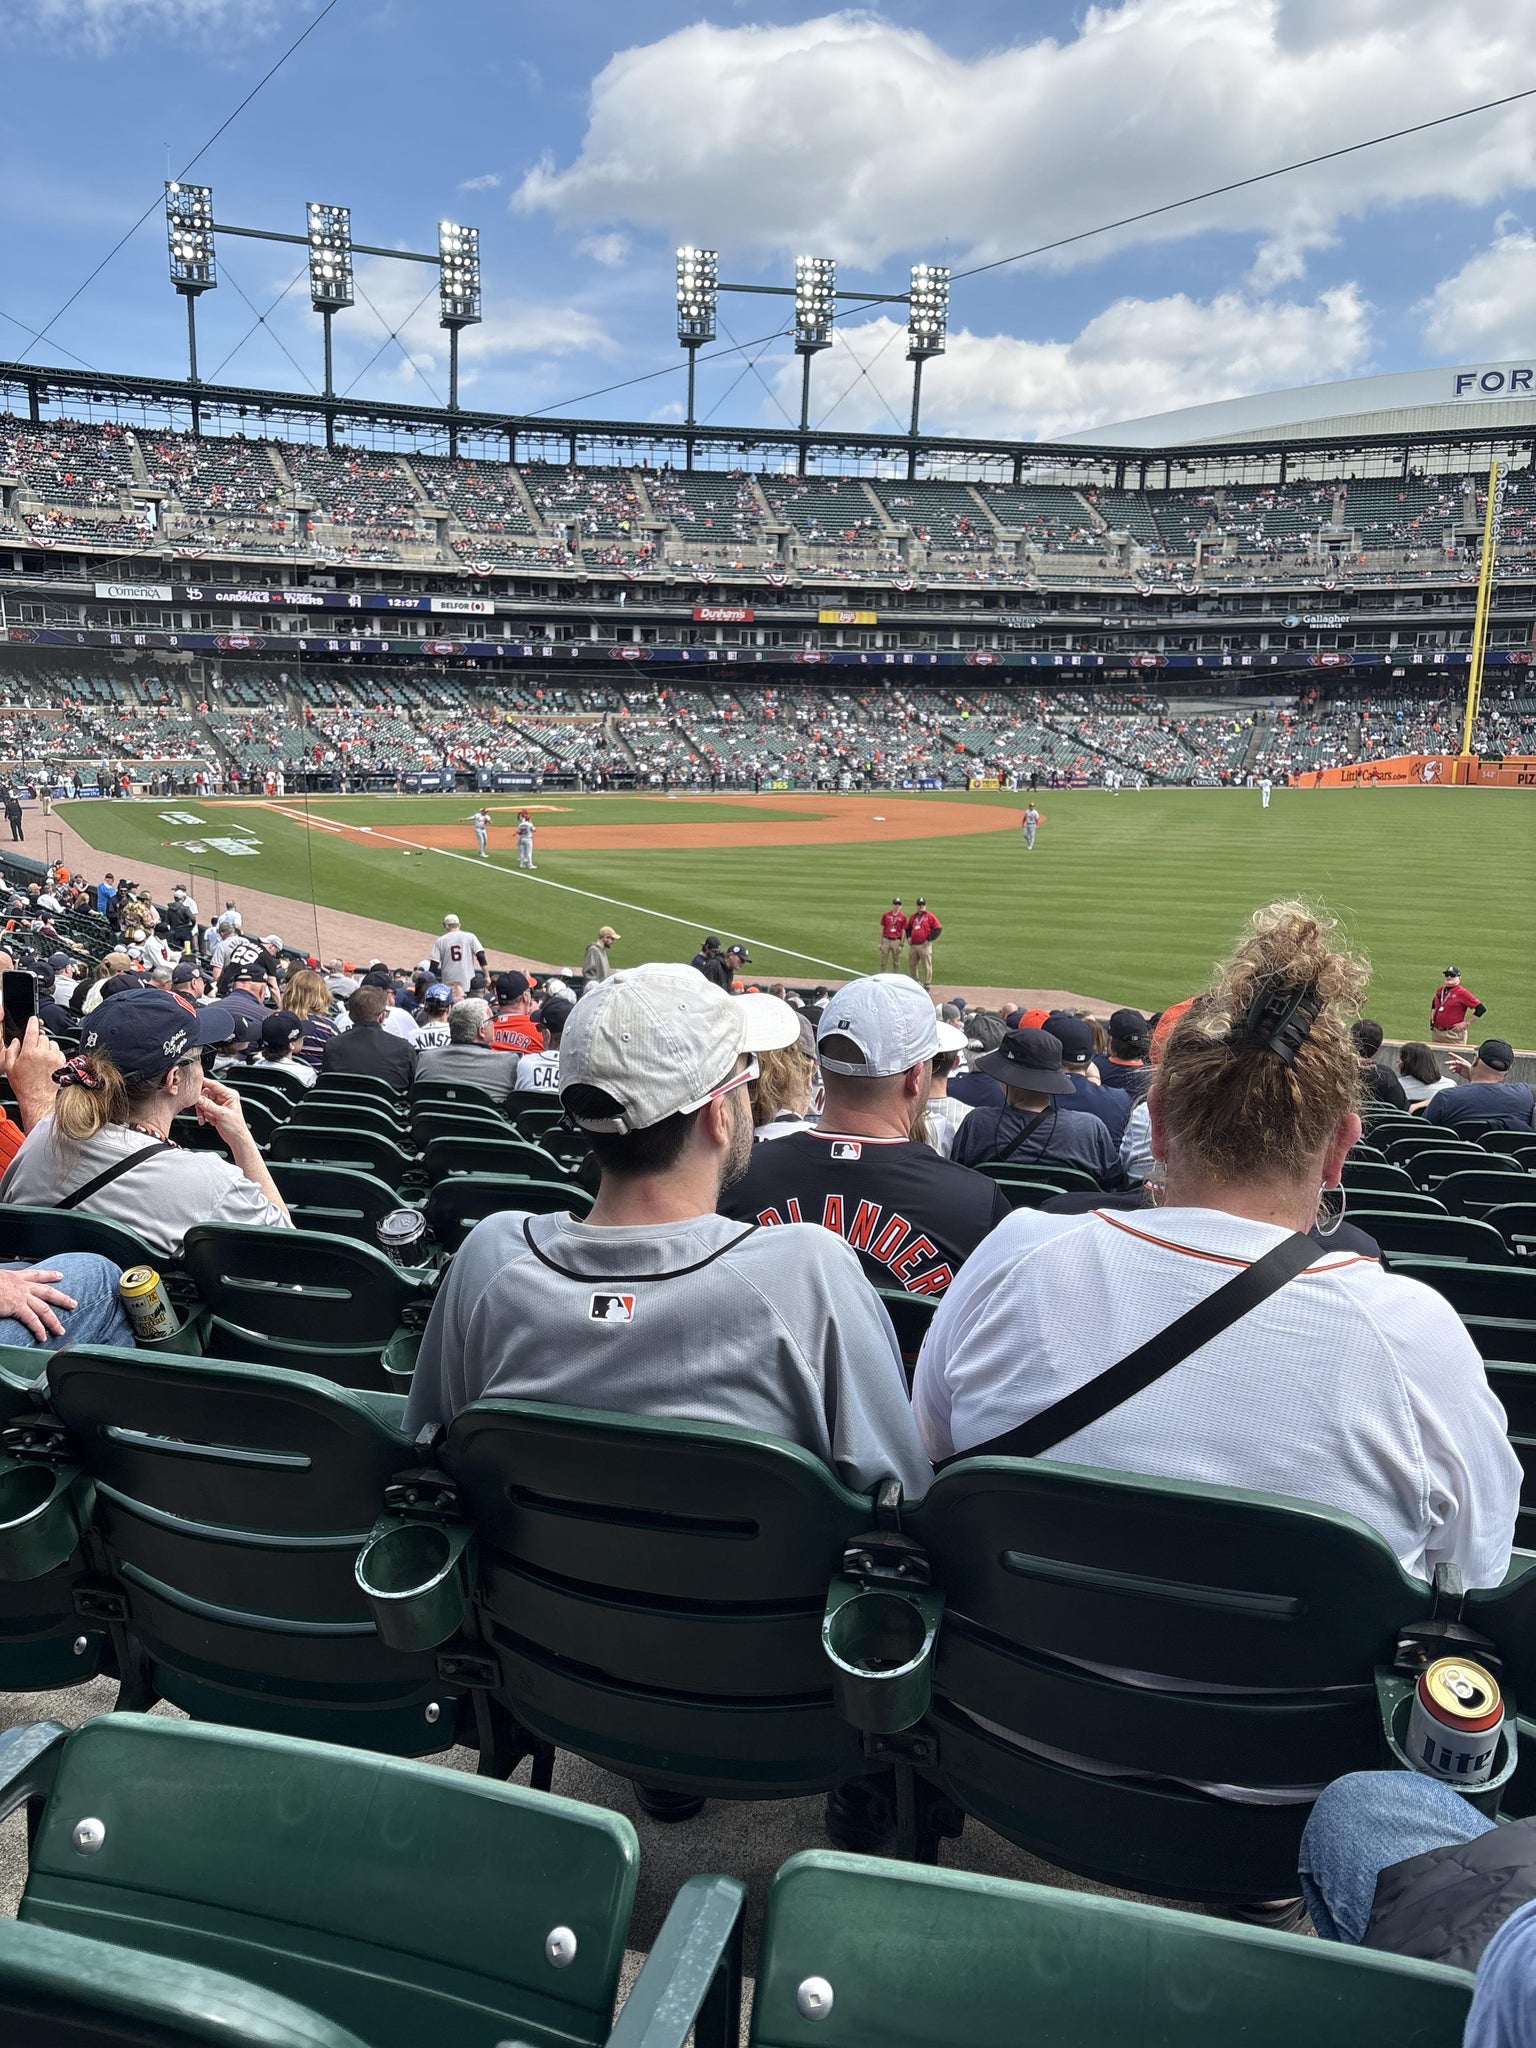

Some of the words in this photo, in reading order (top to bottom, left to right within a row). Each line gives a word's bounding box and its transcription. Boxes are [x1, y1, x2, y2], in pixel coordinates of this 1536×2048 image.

[1455, 369, 1534, 396] FOR
[1489, 479, 1508, 543] Rocket
[387, 599, 420, 608] 12:37
[440, 601, 470, 610] BELFOR
[700, 608, 746, 619] Dunham's
[1302, 614, 1351, 624] Gallagher
[230, 945, 259, 966] 29
[450, 944, 462, 962] 6
[413, 1031, 451, 1050] KINST
